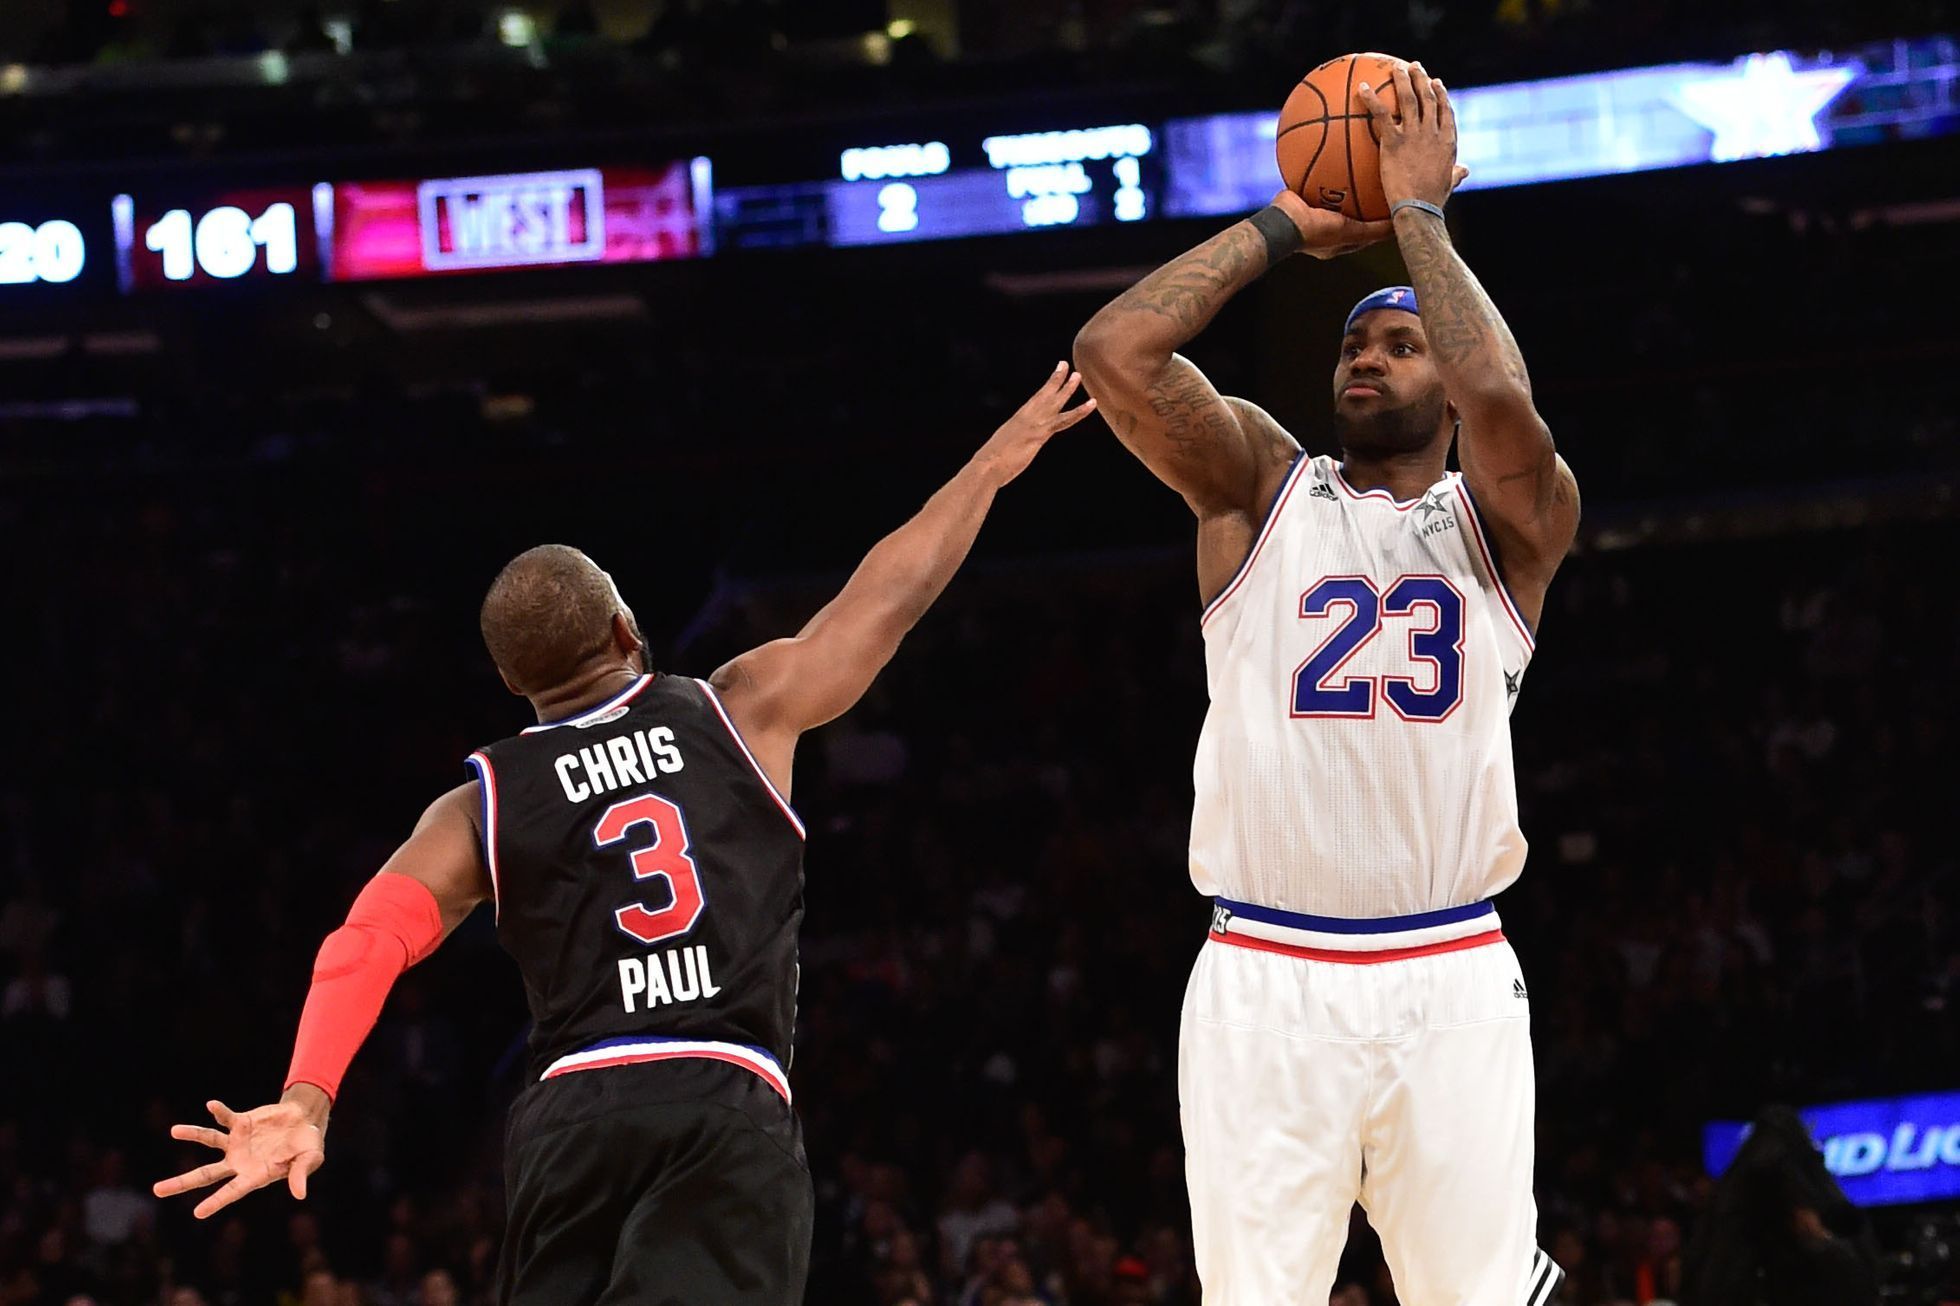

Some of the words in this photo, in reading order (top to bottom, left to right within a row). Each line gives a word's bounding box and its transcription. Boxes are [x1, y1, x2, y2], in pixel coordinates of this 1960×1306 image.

[145, 202, 298, 280] 161
[878, 182, 919, 233] 2
[1289, 574, 1467, 724] 23
[554, 726, 685, 804] CHRIS
[592, 792, 707, 945] 3
[618, 945, 722, 1014] PAUL
